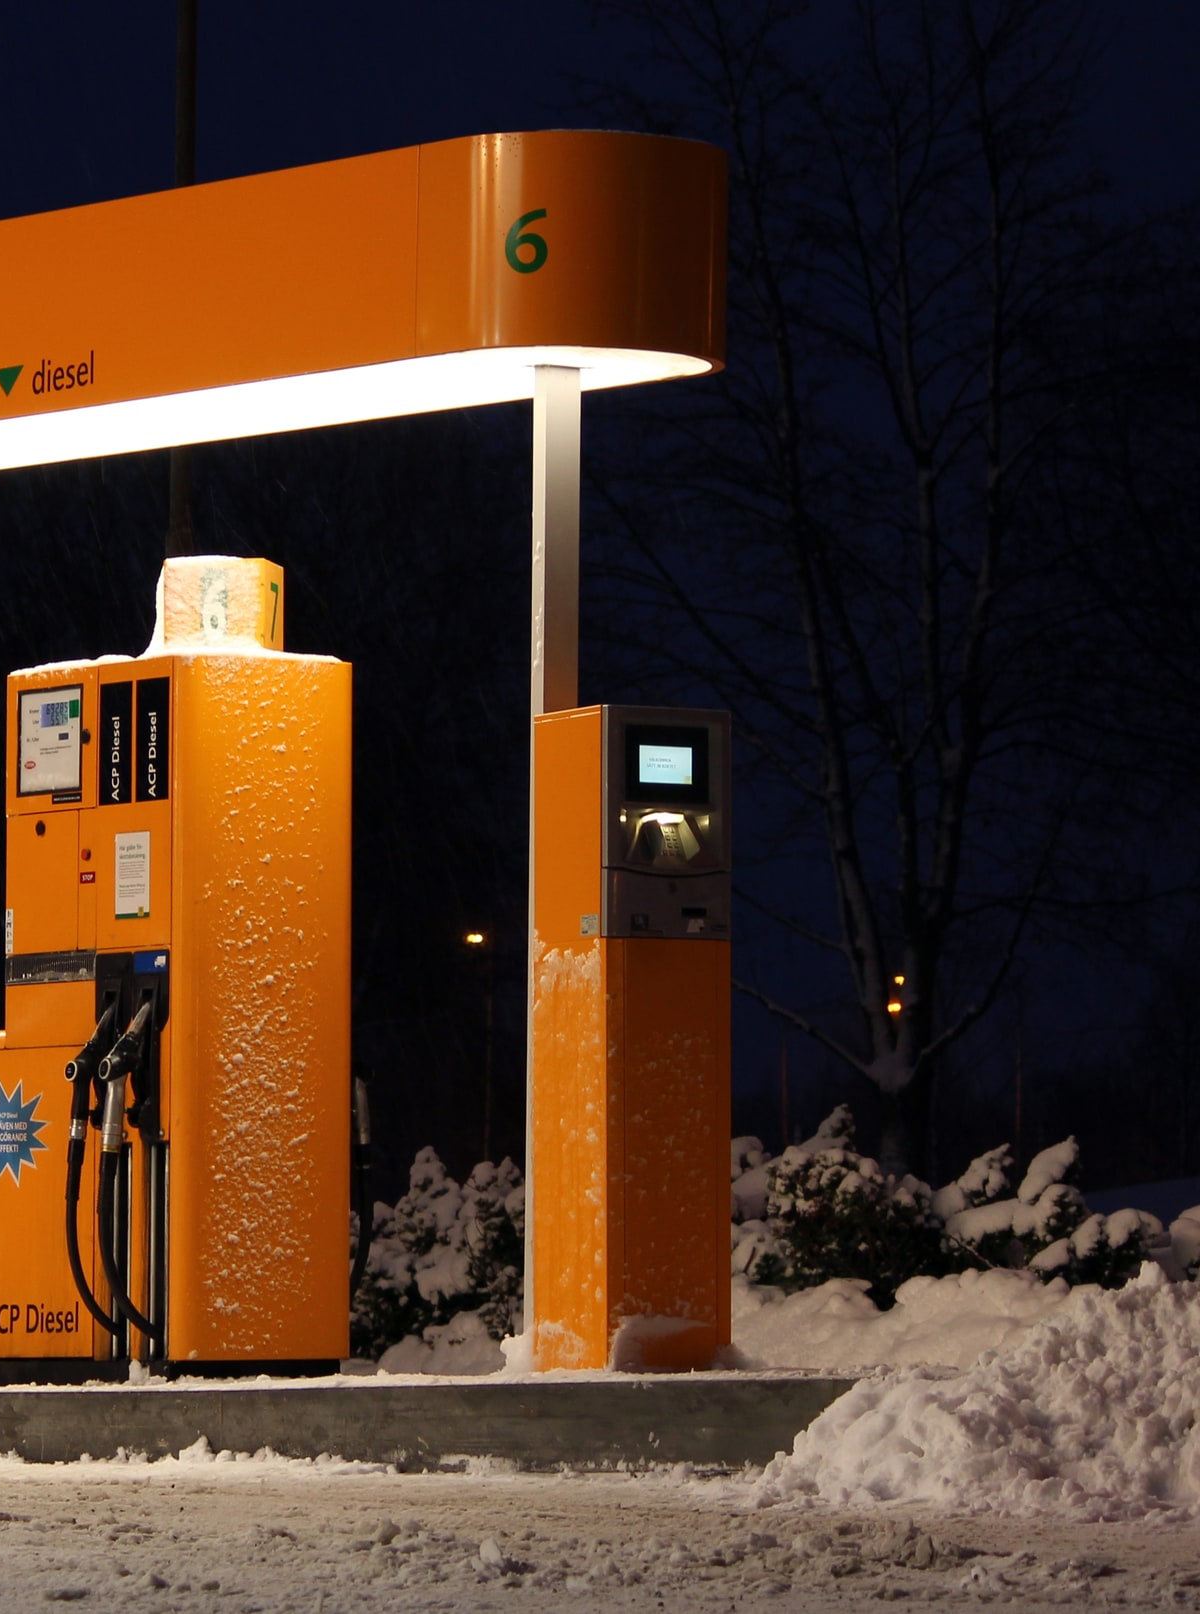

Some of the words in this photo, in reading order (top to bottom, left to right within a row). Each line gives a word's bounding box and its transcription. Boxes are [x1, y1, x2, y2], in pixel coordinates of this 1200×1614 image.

[505, 207, 548, 274] 6
[32, 350, 94, 395] diesel
[270, 581, 279, 643] 7
[111, 716, 120, 763] Diesel
[148, 711, 157, 759] Diesel
[111, 767, 120, 801] ACP
[147, 763, 156, 797] ACP
[82, 873, 94, 882] STOP
[14, 1121, 28, 1131] MED
[26, 1301, 79, 1334] Diesel
